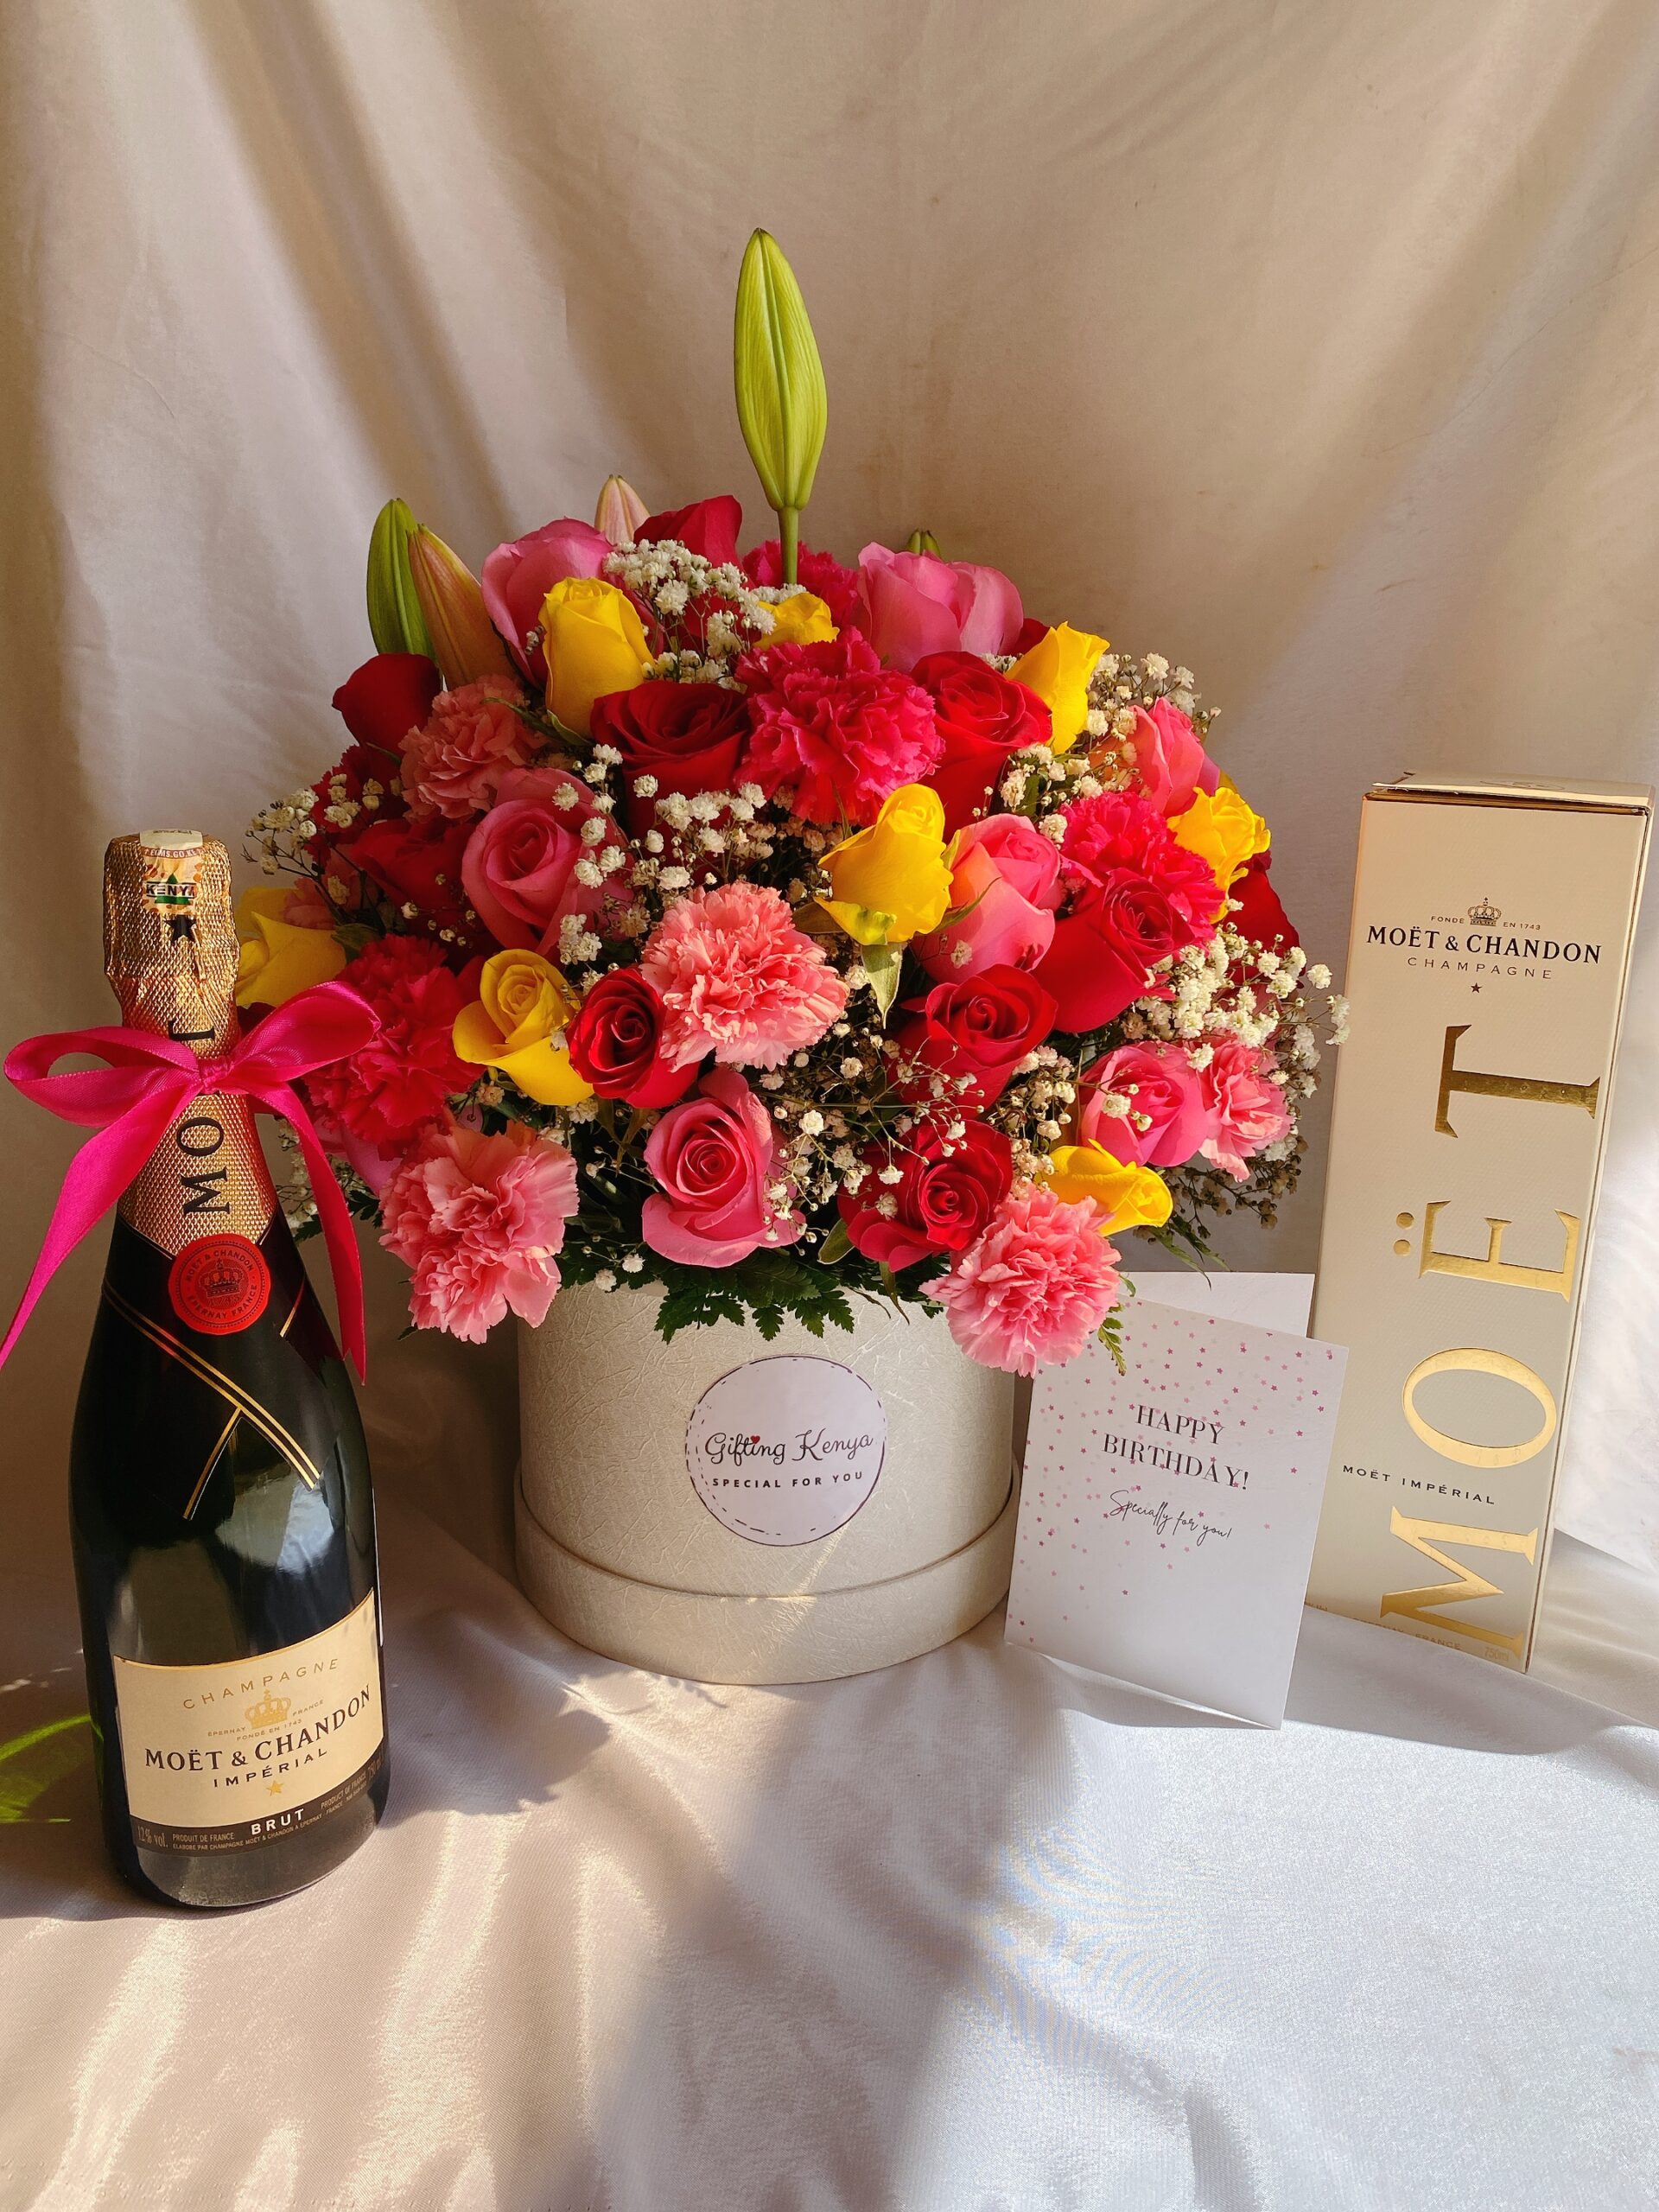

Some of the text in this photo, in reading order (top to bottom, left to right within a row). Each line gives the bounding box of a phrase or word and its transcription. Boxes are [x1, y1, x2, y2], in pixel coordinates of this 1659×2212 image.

[1366, 925, 1602, 965] MOËT & CHANDON
[1407, 957, 1554, 980] CHAMPAGNE
[213, 1249, 255, 1273] CHANDON
[231, 1284, 257, 1318] FRANCE
[1380, 1024, 1601, 1660] MOËT
[1135, 1404, 1225, 1446] HAPPY
[704, 1427, 874, 1467] Gifting Kenya
[1101, 1433, 1249, 1491] BIRTHDAY!
[712, 1471, 863, 1489] SPECIAL FOR YOU
[1343, 1464, 1496, 1505] MOËT IMPÉRIAL
[1109, 1489, 1233, 1547] Specially for you!
[182, 1657, 339, 1710] CHAMPAGNE
[144, 1683, 372, 1771] MOËT & CHANDON
[283, 1718, 303, 1729] 1743
[292, 1699, 325, 1717] FRANCE
[213, 1747, 328, 1789] IMPÉRIAL
[172, 1832, 235, 1843] PRODUIT DE FRANCE
[251, 1808, 305, 1836] BRUT
